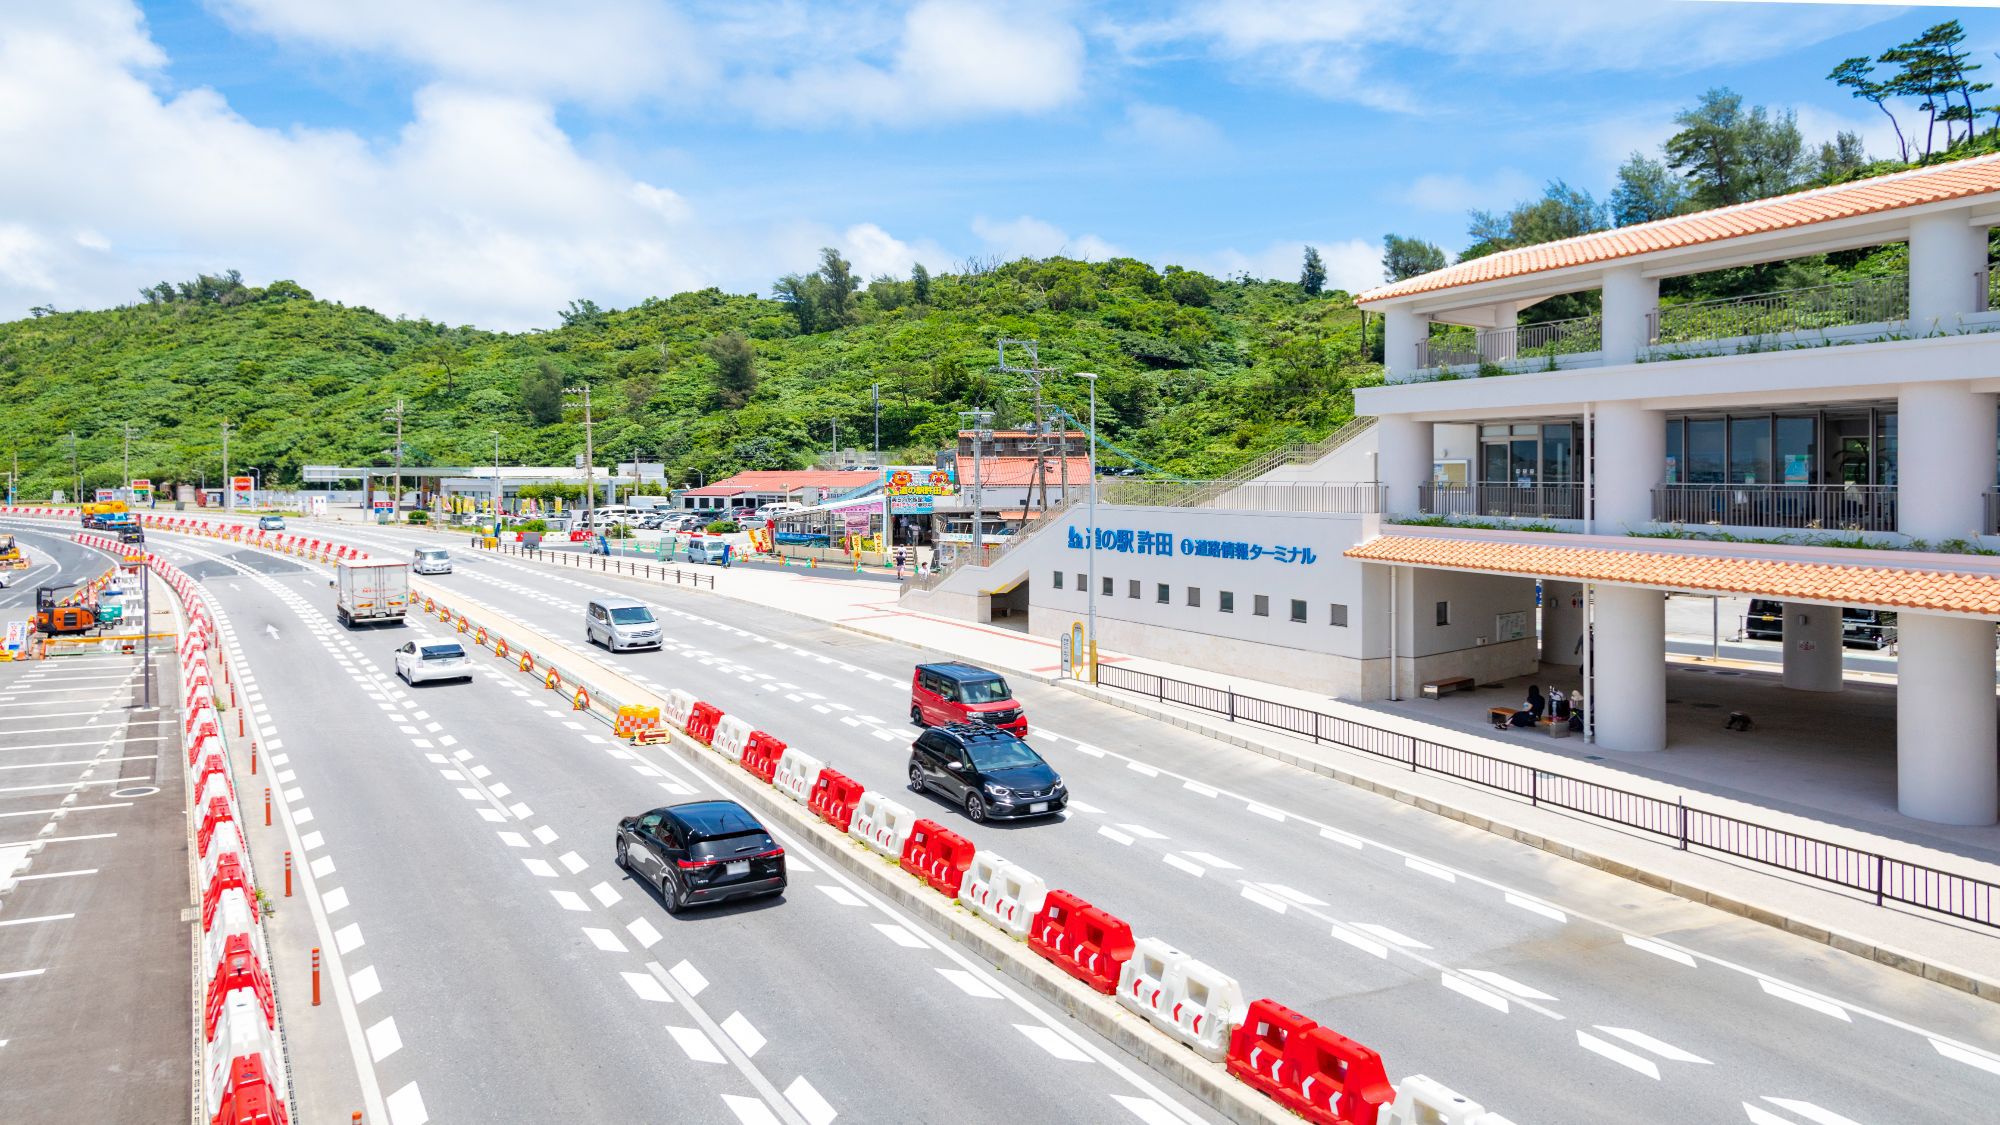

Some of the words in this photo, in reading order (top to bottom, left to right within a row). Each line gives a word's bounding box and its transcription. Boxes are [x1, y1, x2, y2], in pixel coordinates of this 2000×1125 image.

[1085, 527, 1135, 553] 道の駅
[1137, 530, 1173, 556] 許田
[1195, 539, 1317, 565] 道路情報ターミナル
